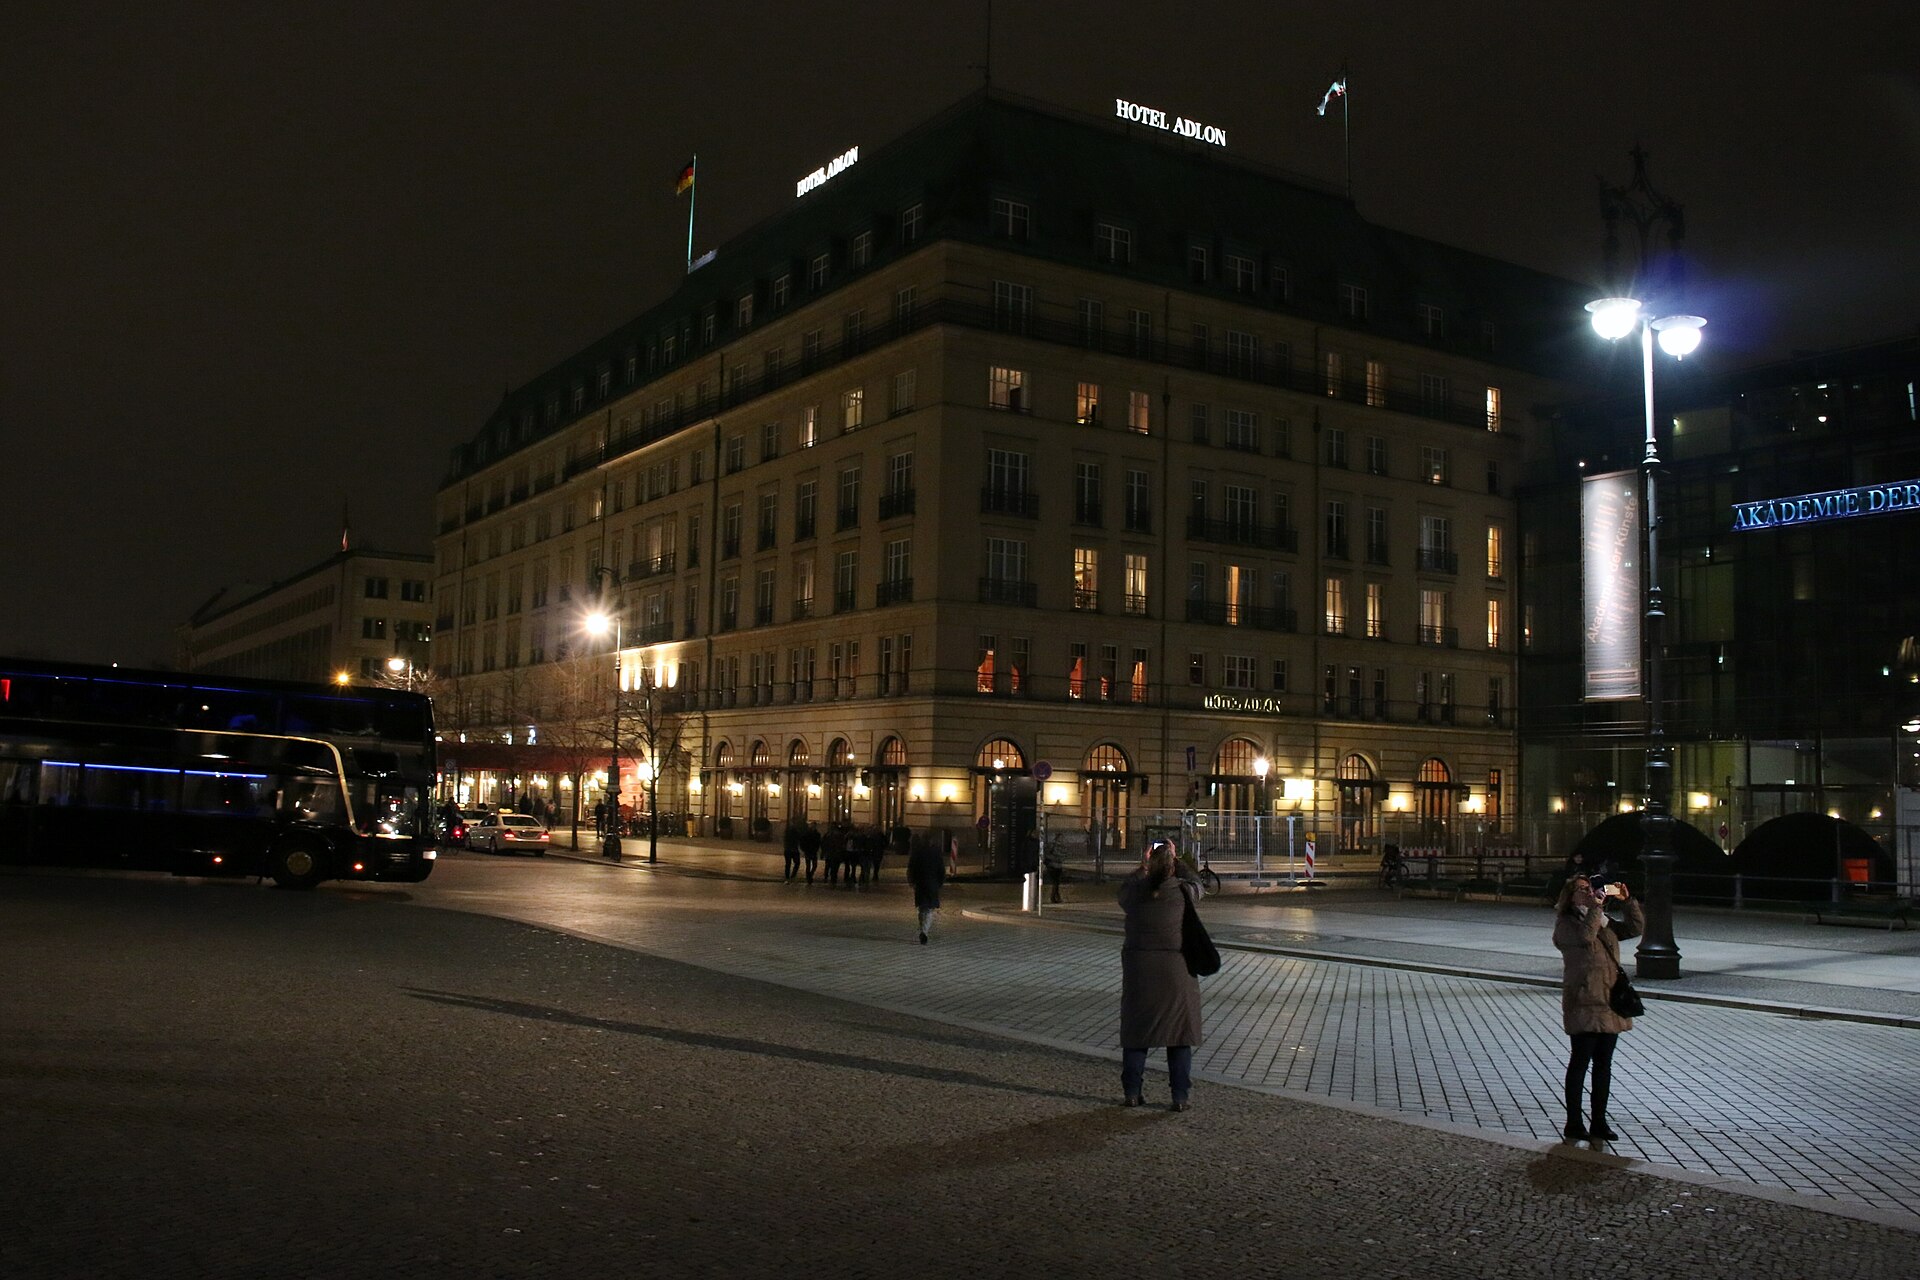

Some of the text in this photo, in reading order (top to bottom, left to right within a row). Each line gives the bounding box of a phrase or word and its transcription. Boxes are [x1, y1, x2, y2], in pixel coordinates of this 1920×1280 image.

[1116, 99, 1226, 146] HOTEL ADLON
[826, 146, 859, 180] ADLON
[1734, 483, 1920, 529] AKADEMIE DER
[1587, 497, 1638, 644] Akademie der Künste
